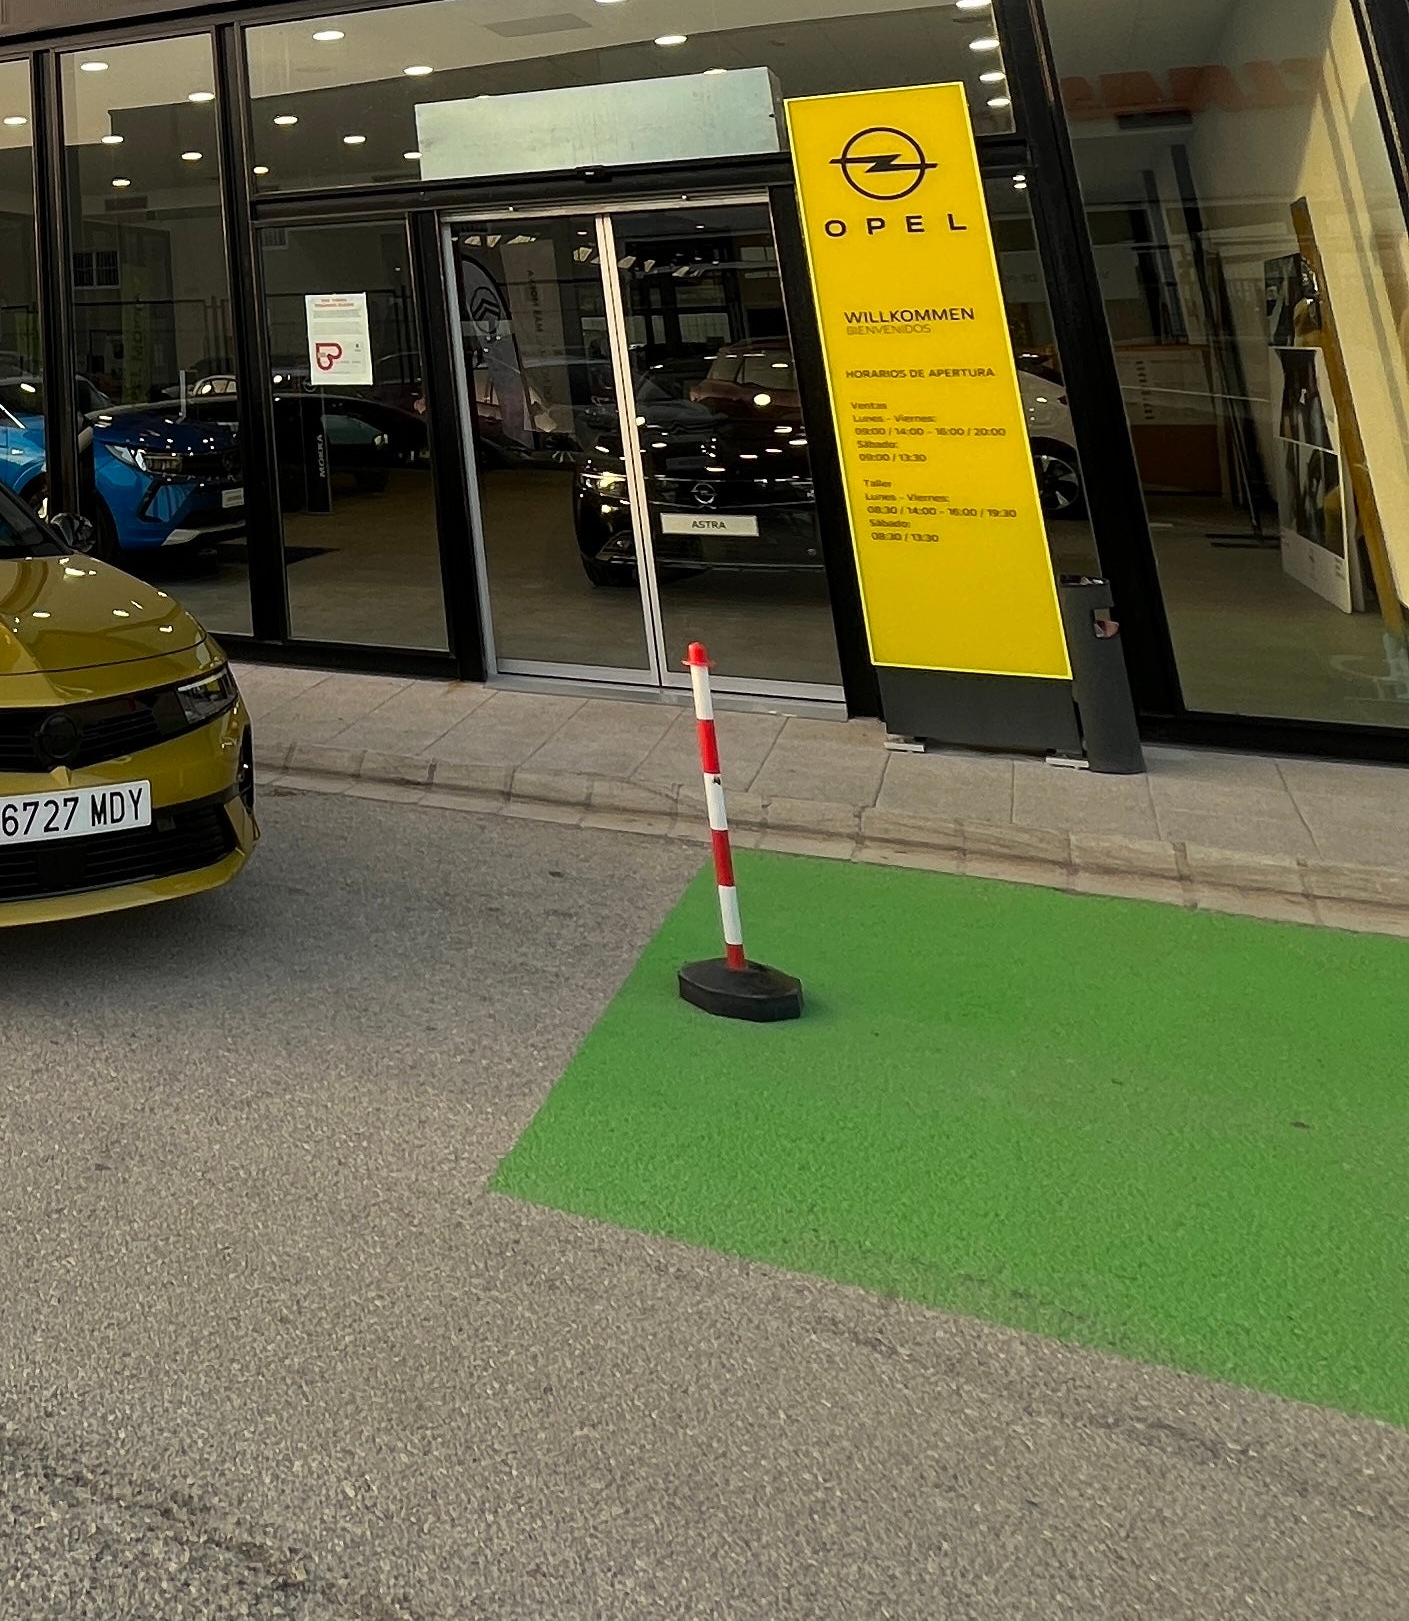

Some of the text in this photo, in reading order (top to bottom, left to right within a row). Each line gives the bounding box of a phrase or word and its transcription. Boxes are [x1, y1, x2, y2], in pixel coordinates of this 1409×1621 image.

[824, 213, 968, 238] OPEL
[843, 308, 976, 324] WILLKOMMEN
[846, 324, 932, 336] BIENVENIDOS
[846, 368, 995, 379] HORARIOS DE APERTURA
[691, 520, 727, 530] ASTRA
[1, 796, 80, 837] 6727
[90, 788, 143, 827] MDY
